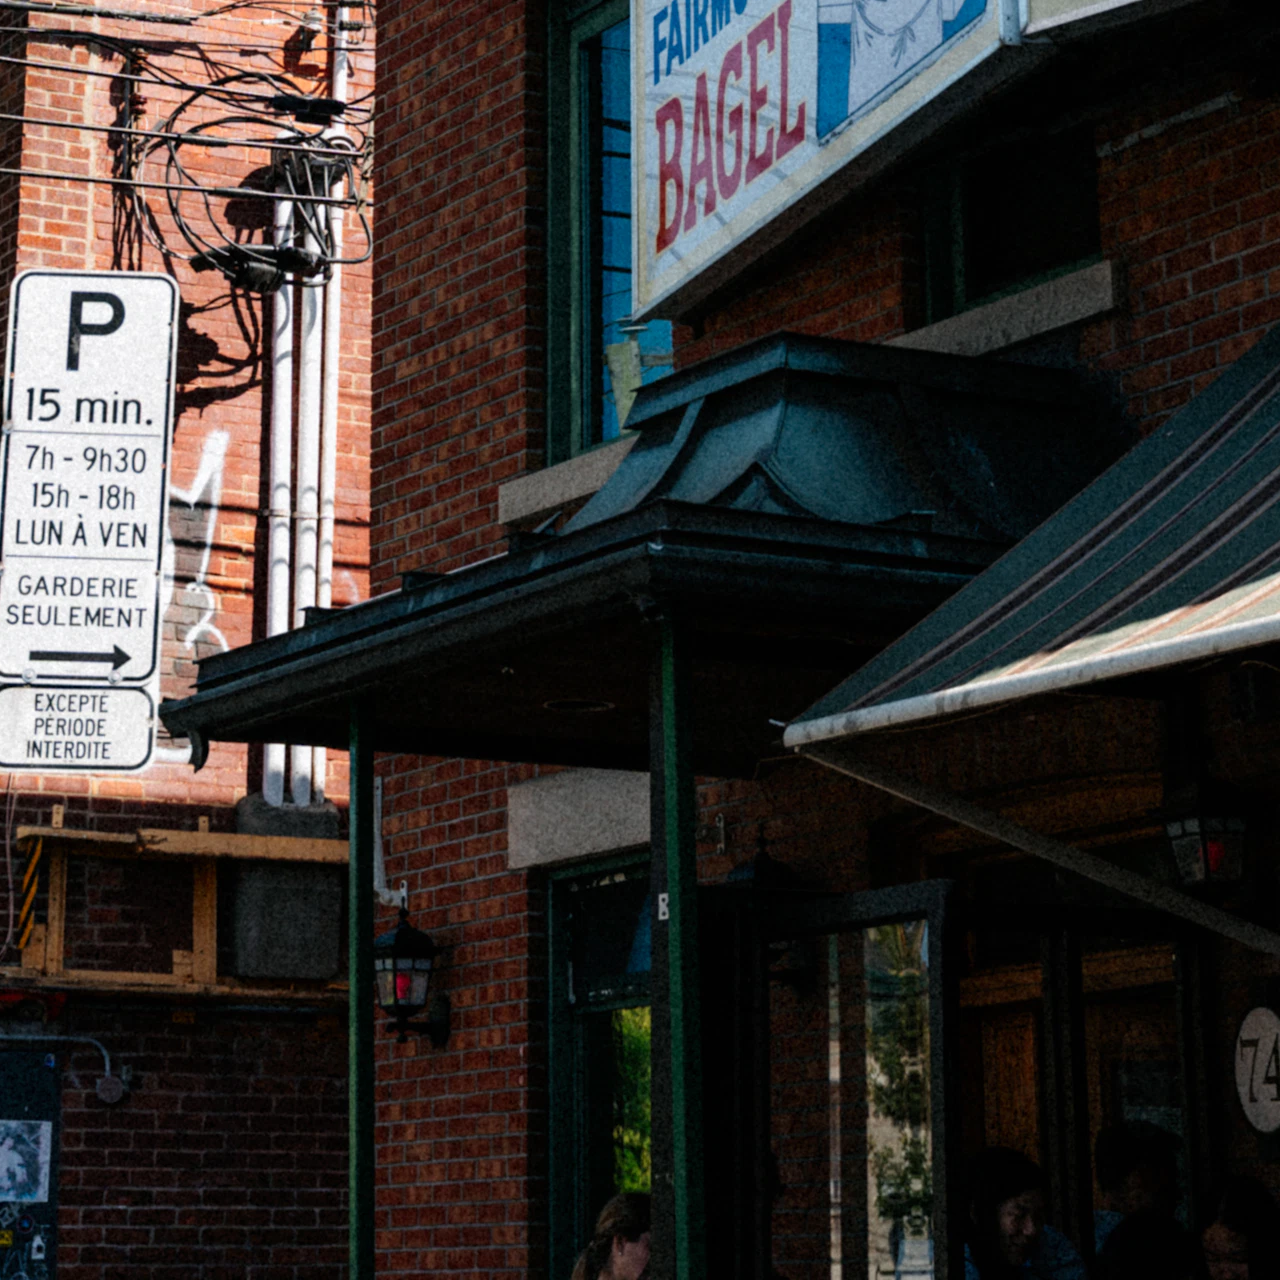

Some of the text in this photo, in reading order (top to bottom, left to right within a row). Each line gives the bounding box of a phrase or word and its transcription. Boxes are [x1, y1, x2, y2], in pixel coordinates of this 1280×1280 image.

[66, 291, 126, 371] P
[27, 387, 152, 426] 15 min.
[26, 445, 54, 470] 7h
[83, 446, 146, 474] 9h30
[32, 482, 69, 508] 15h
[99, 484, 135, 510] 18h
[15, 513, 147, 548] LUN À VEN
[18, 575, 138, 598] GARDERIE
[6, 604, 147, 627] SEULEMENT
[34, 692, 109, 713] EXCEPTÉ
[34, 714, 106, 737] PÉRIODE
[26, 740, 112, 759] INTERDITE
